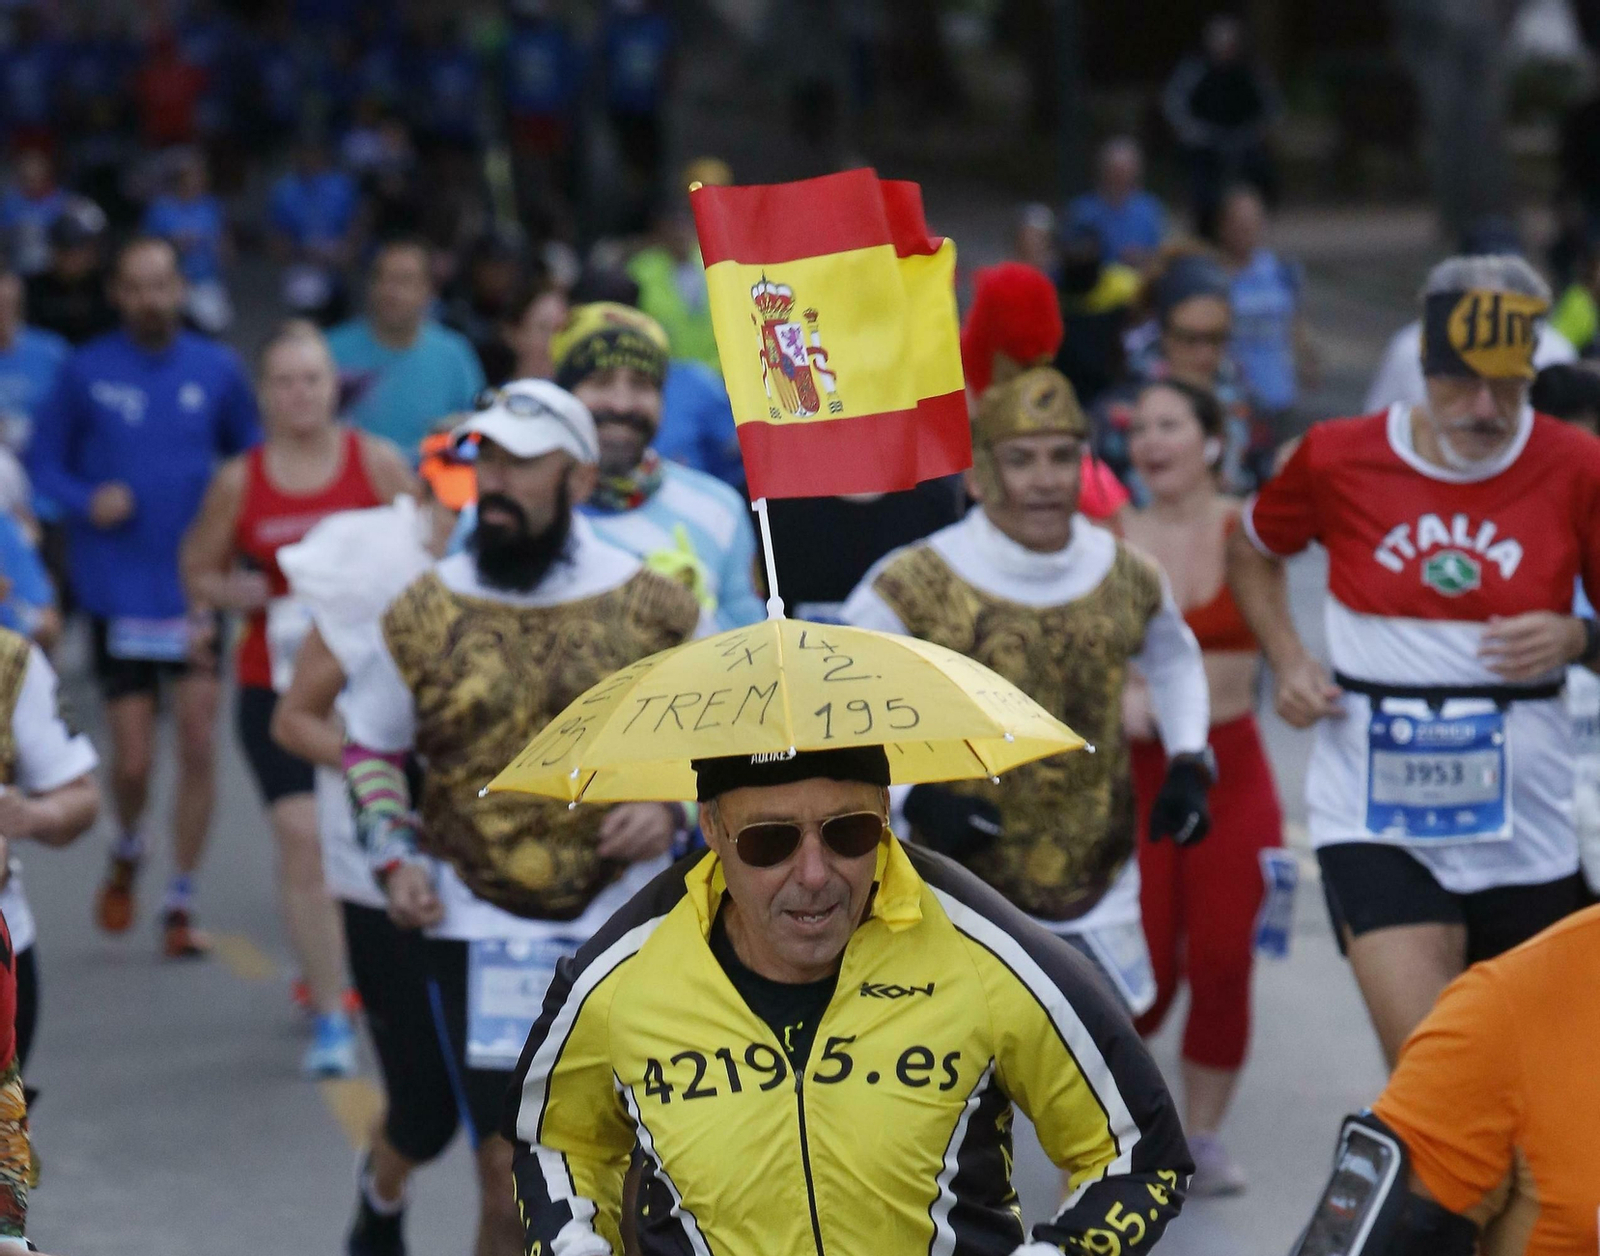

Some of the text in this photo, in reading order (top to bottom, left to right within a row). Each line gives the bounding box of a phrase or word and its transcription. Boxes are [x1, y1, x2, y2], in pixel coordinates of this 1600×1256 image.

[1374, 513, 1523, 581] ITALIA
[622, 681, 779, 734] TREM
[814, 697, 921, 740] 195
[860, 982, 936, 999] KON
